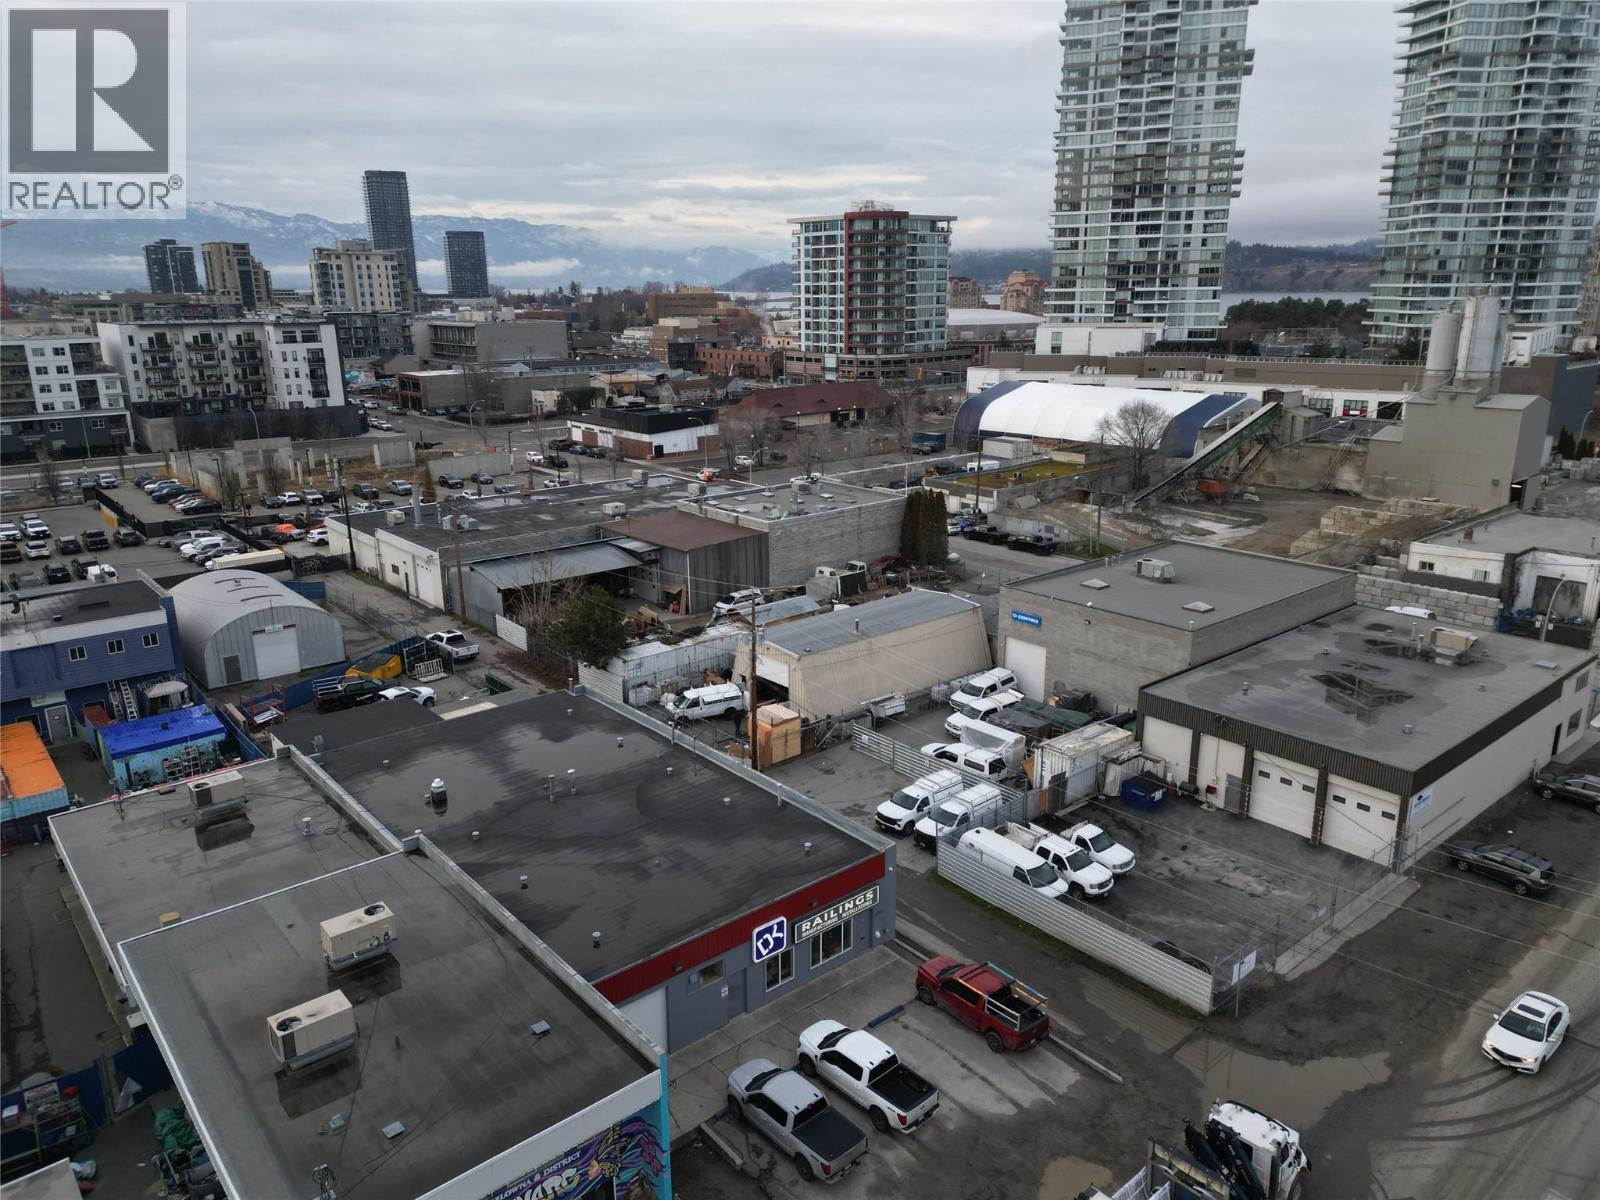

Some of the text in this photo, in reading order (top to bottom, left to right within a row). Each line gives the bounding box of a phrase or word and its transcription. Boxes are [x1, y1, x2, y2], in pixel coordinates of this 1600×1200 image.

[801, 890, 874, 932] RAILINGS
[802, 900, 873, 938] MANUFACTURING INSTALLATIONS
[756, 924, 784, 956] DK
[544, 1151, 582, 1176] DISTRICT
